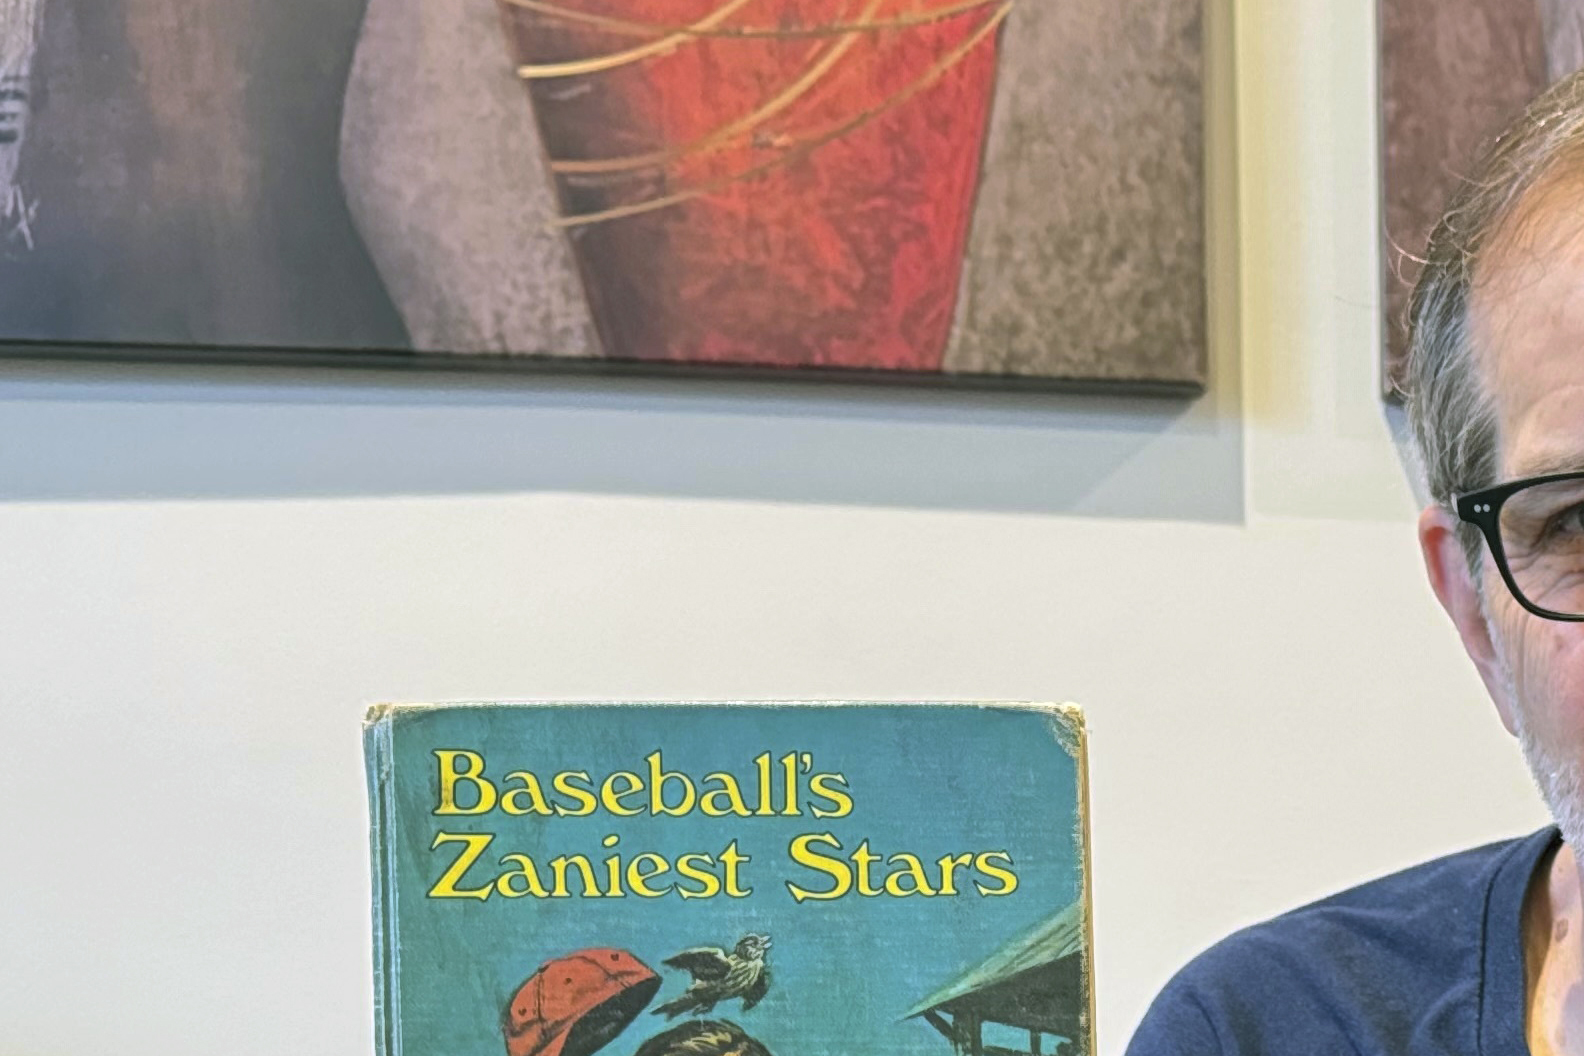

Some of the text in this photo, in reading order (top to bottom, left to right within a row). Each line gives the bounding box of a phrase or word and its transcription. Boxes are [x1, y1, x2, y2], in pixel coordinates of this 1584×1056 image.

[432, 749, 854, 819] Baseball's
[426, 831, 1020, 904] Zaniest Stars
